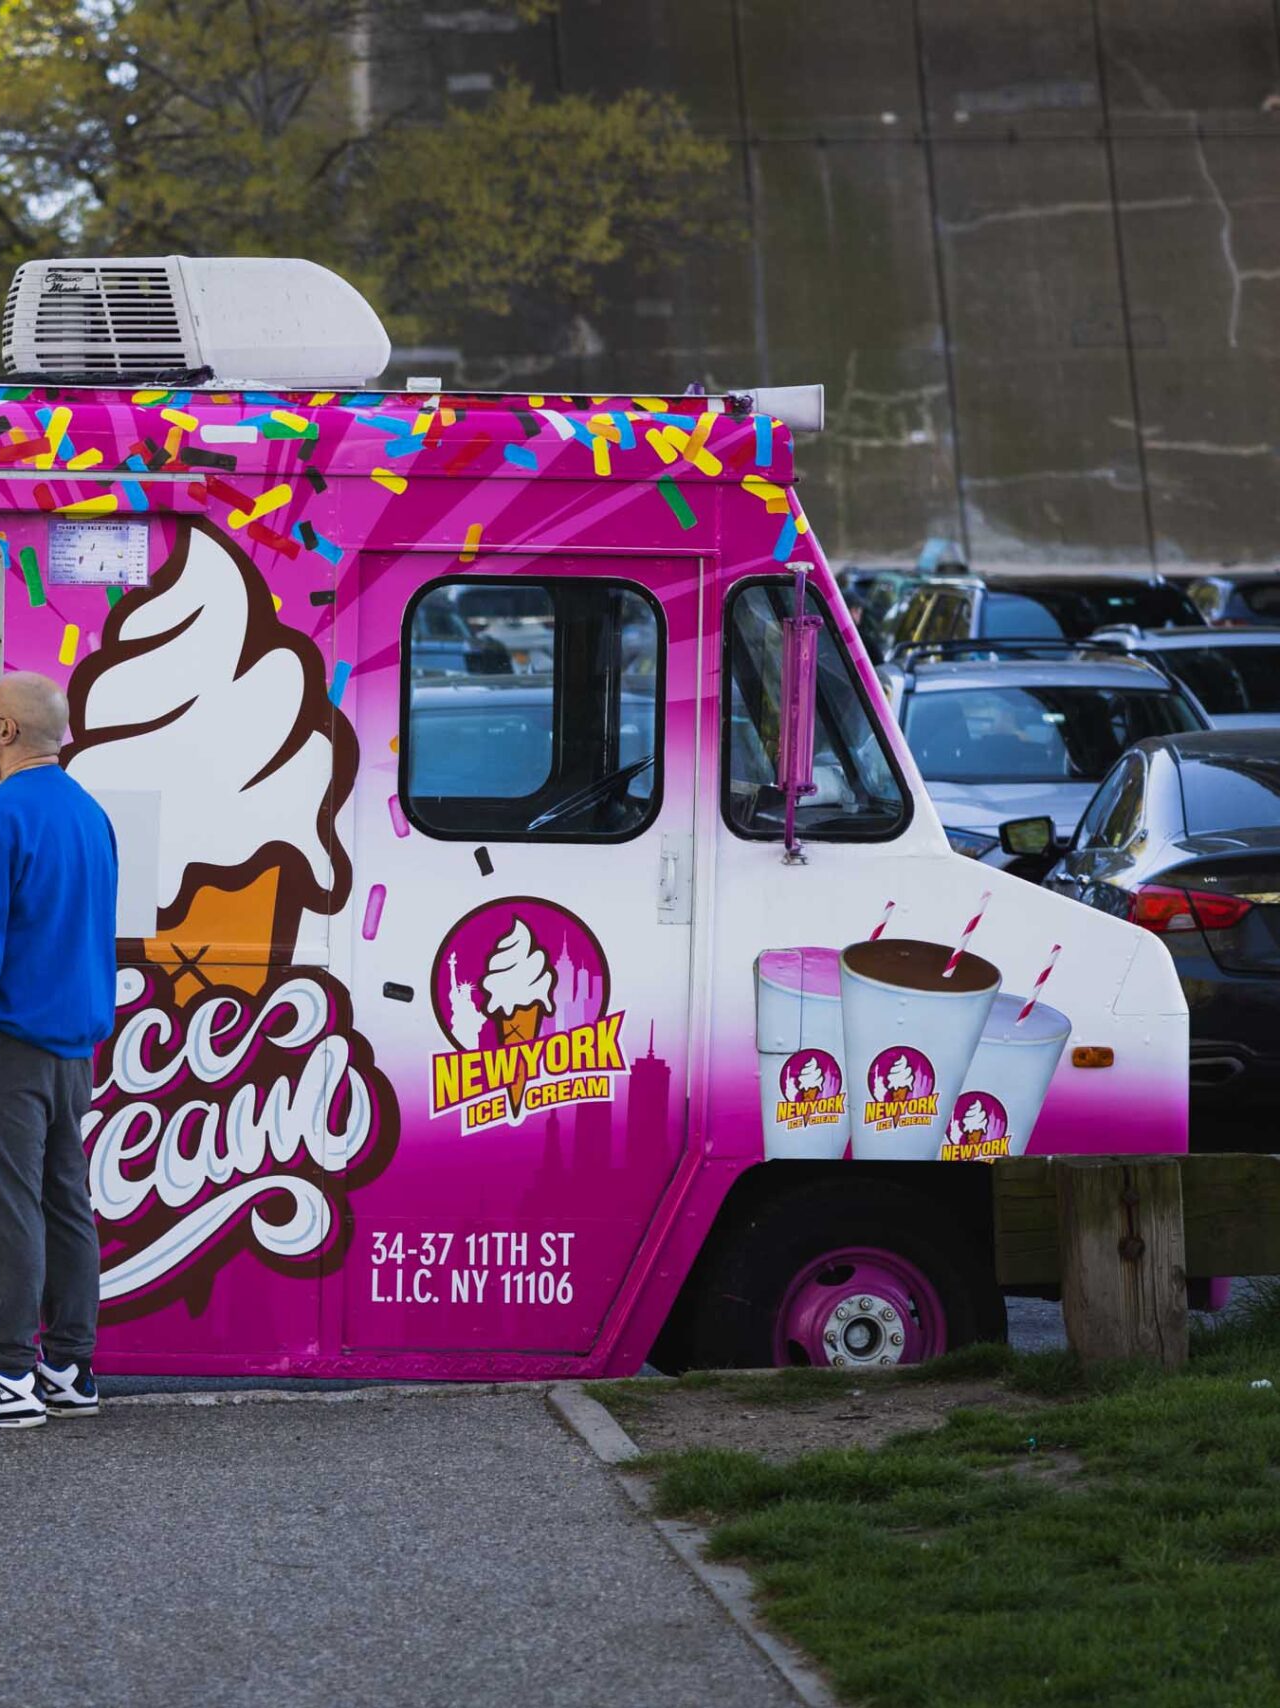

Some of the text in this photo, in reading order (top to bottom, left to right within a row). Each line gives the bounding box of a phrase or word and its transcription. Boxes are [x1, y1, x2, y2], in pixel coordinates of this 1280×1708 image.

[467, 1076, 610, 1128] ICE CREAM
[788, 1114, 839, 1130] ICE CREAM
[876, 1116, 932, 1132] ICE CREAM
[371, 1232, 575, 1267] 34-37 11TH ST
[371, 1268, 574, 1305] L.I.C. NY 11106
